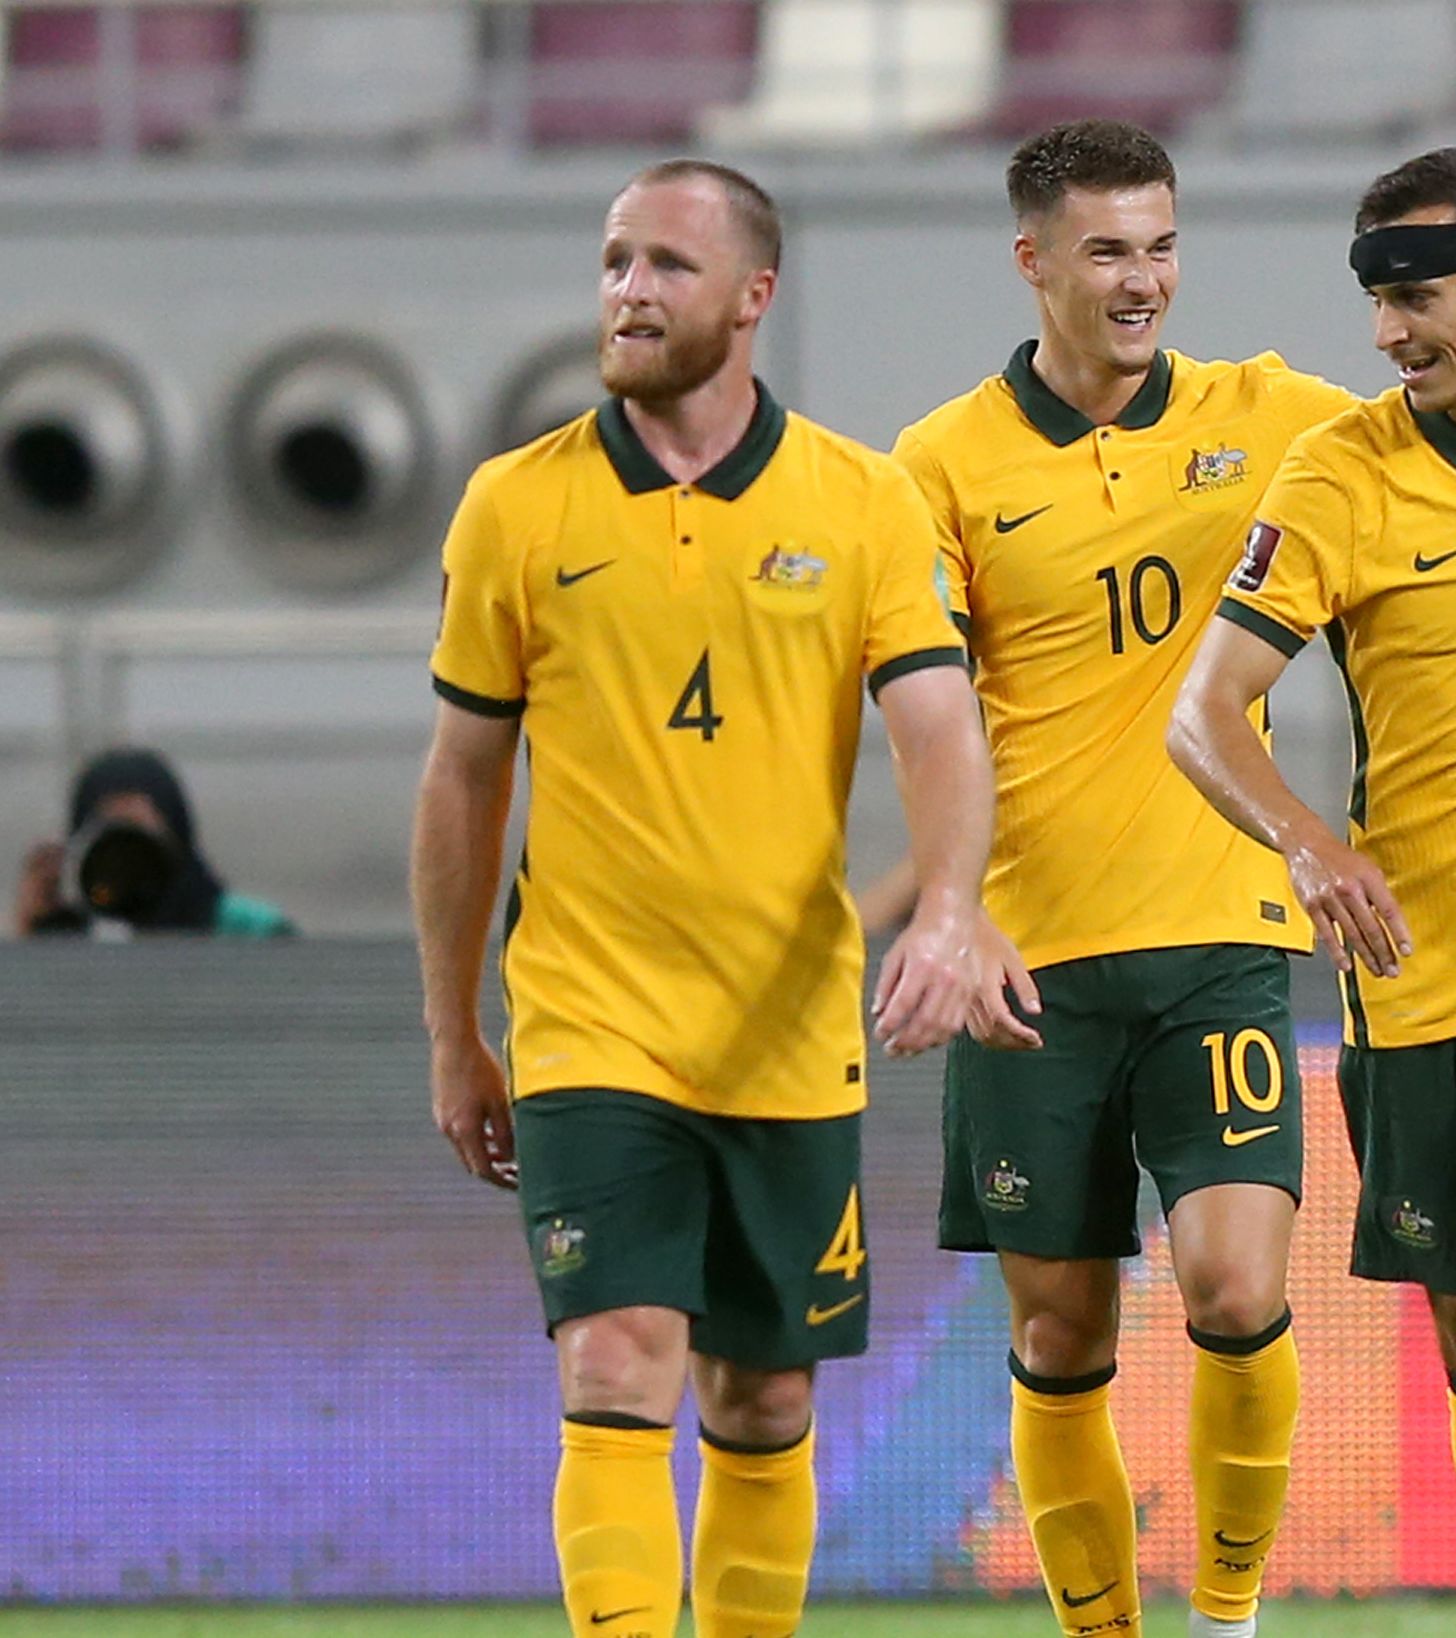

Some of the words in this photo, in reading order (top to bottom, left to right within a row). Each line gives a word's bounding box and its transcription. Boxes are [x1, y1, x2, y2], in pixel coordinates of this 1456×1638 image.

[1095, 555, 1182, 655] 10
[667, 645, 724, 742] 4
[1201, 1027, 1283, 1115] 10
[814, 1182, 868, 1282] 4
